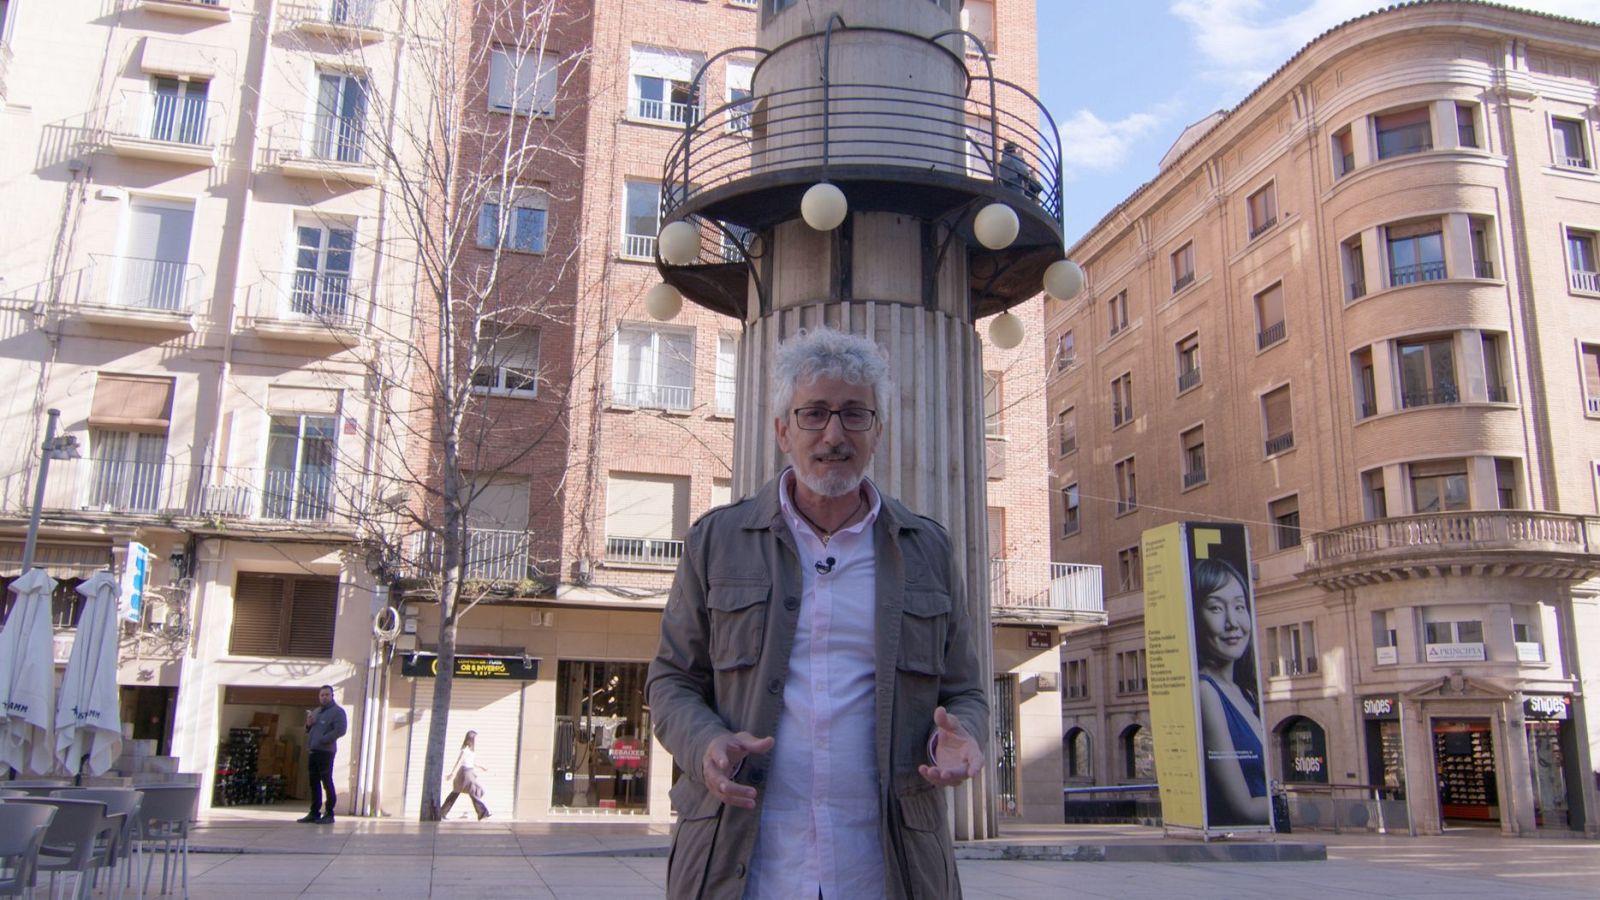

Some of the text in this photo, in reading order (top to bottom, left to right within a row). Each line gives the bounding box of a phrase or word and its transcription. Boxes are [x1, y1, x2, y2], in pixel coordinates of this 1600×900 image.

[1364, 699, 1391, 716] snipes
[1530, 696, 1566, 716] snipes
[1295, 756, 1320, 774] snipes
